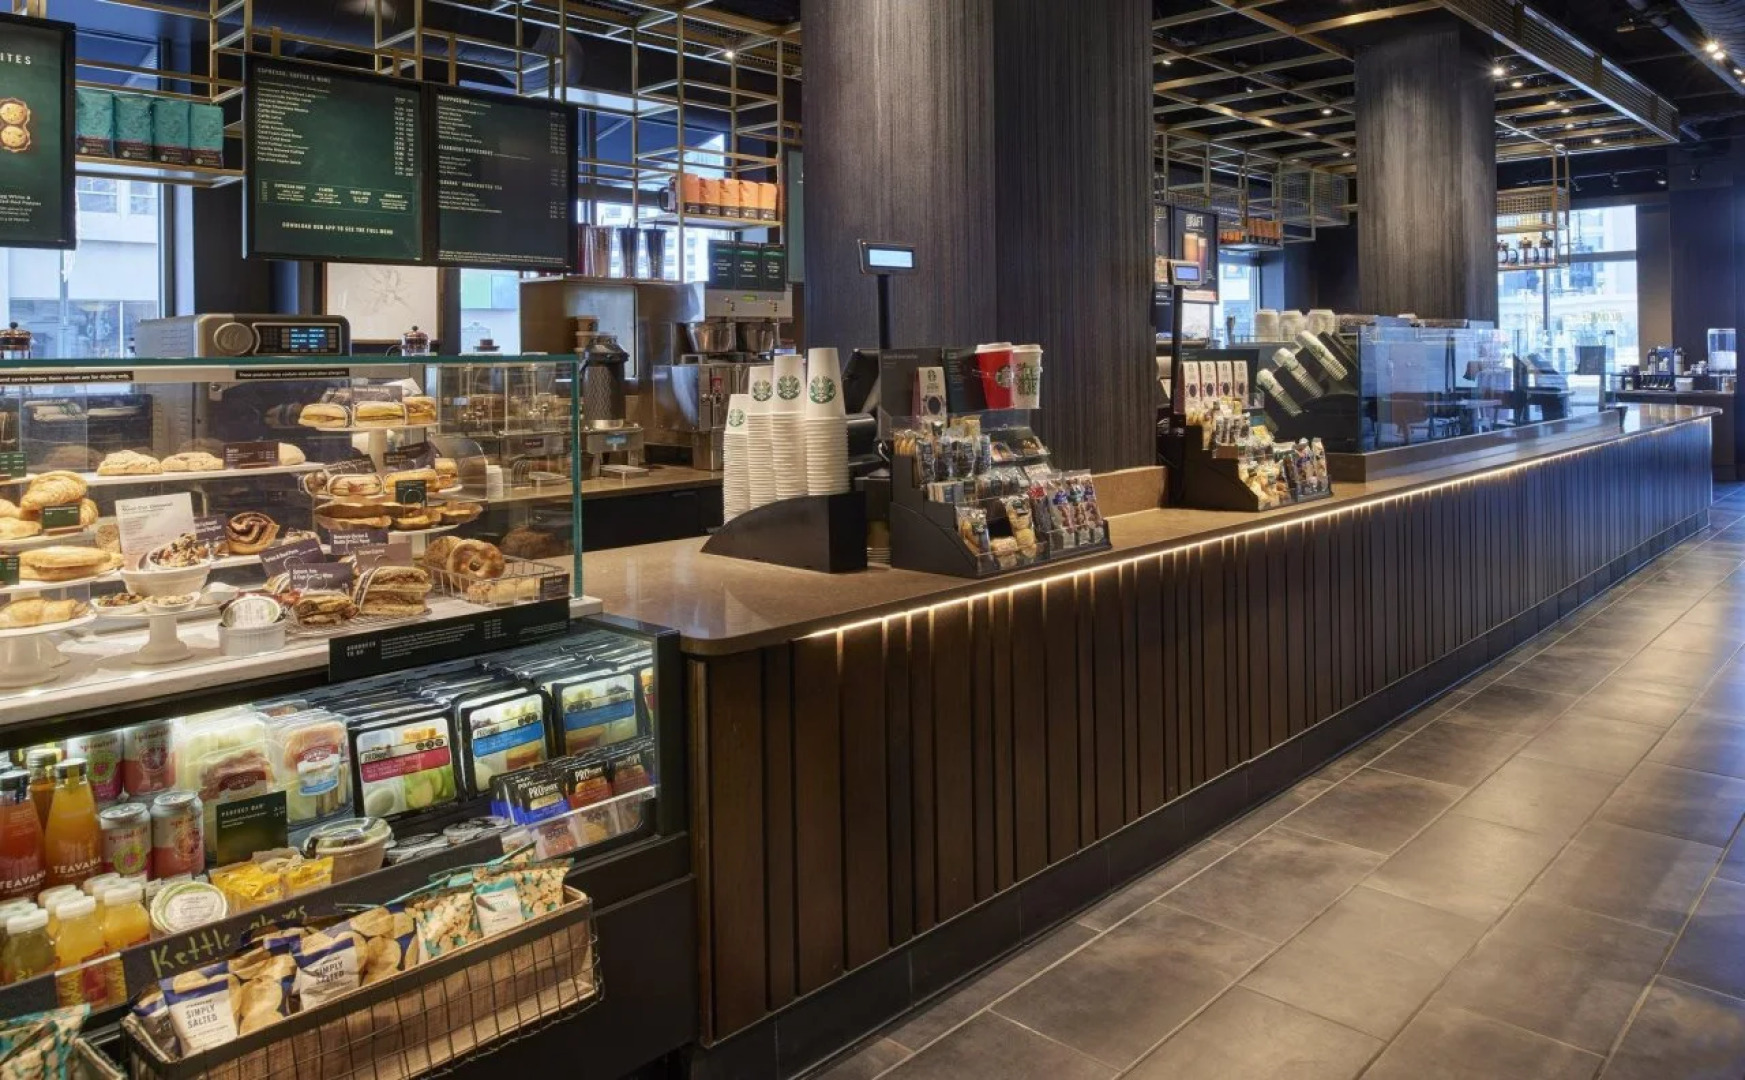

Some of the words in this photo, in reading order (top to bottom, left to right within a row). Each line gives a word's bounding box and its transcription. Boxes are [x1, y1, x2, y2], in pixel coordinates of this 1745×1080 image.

[282, 222, 312, 230] DOWNLOAD
[313, 223, 324, 231] OUR
[325, 224, 336, 232] APP
[337, 224, 344, 232] TO
[345, 225, 354, 233] SEE
[150, 929, 231, 979] Kettle
[186, 1003, 215, 1020] SIMPLY
[187, 1014, 218, 1029] SALTED
